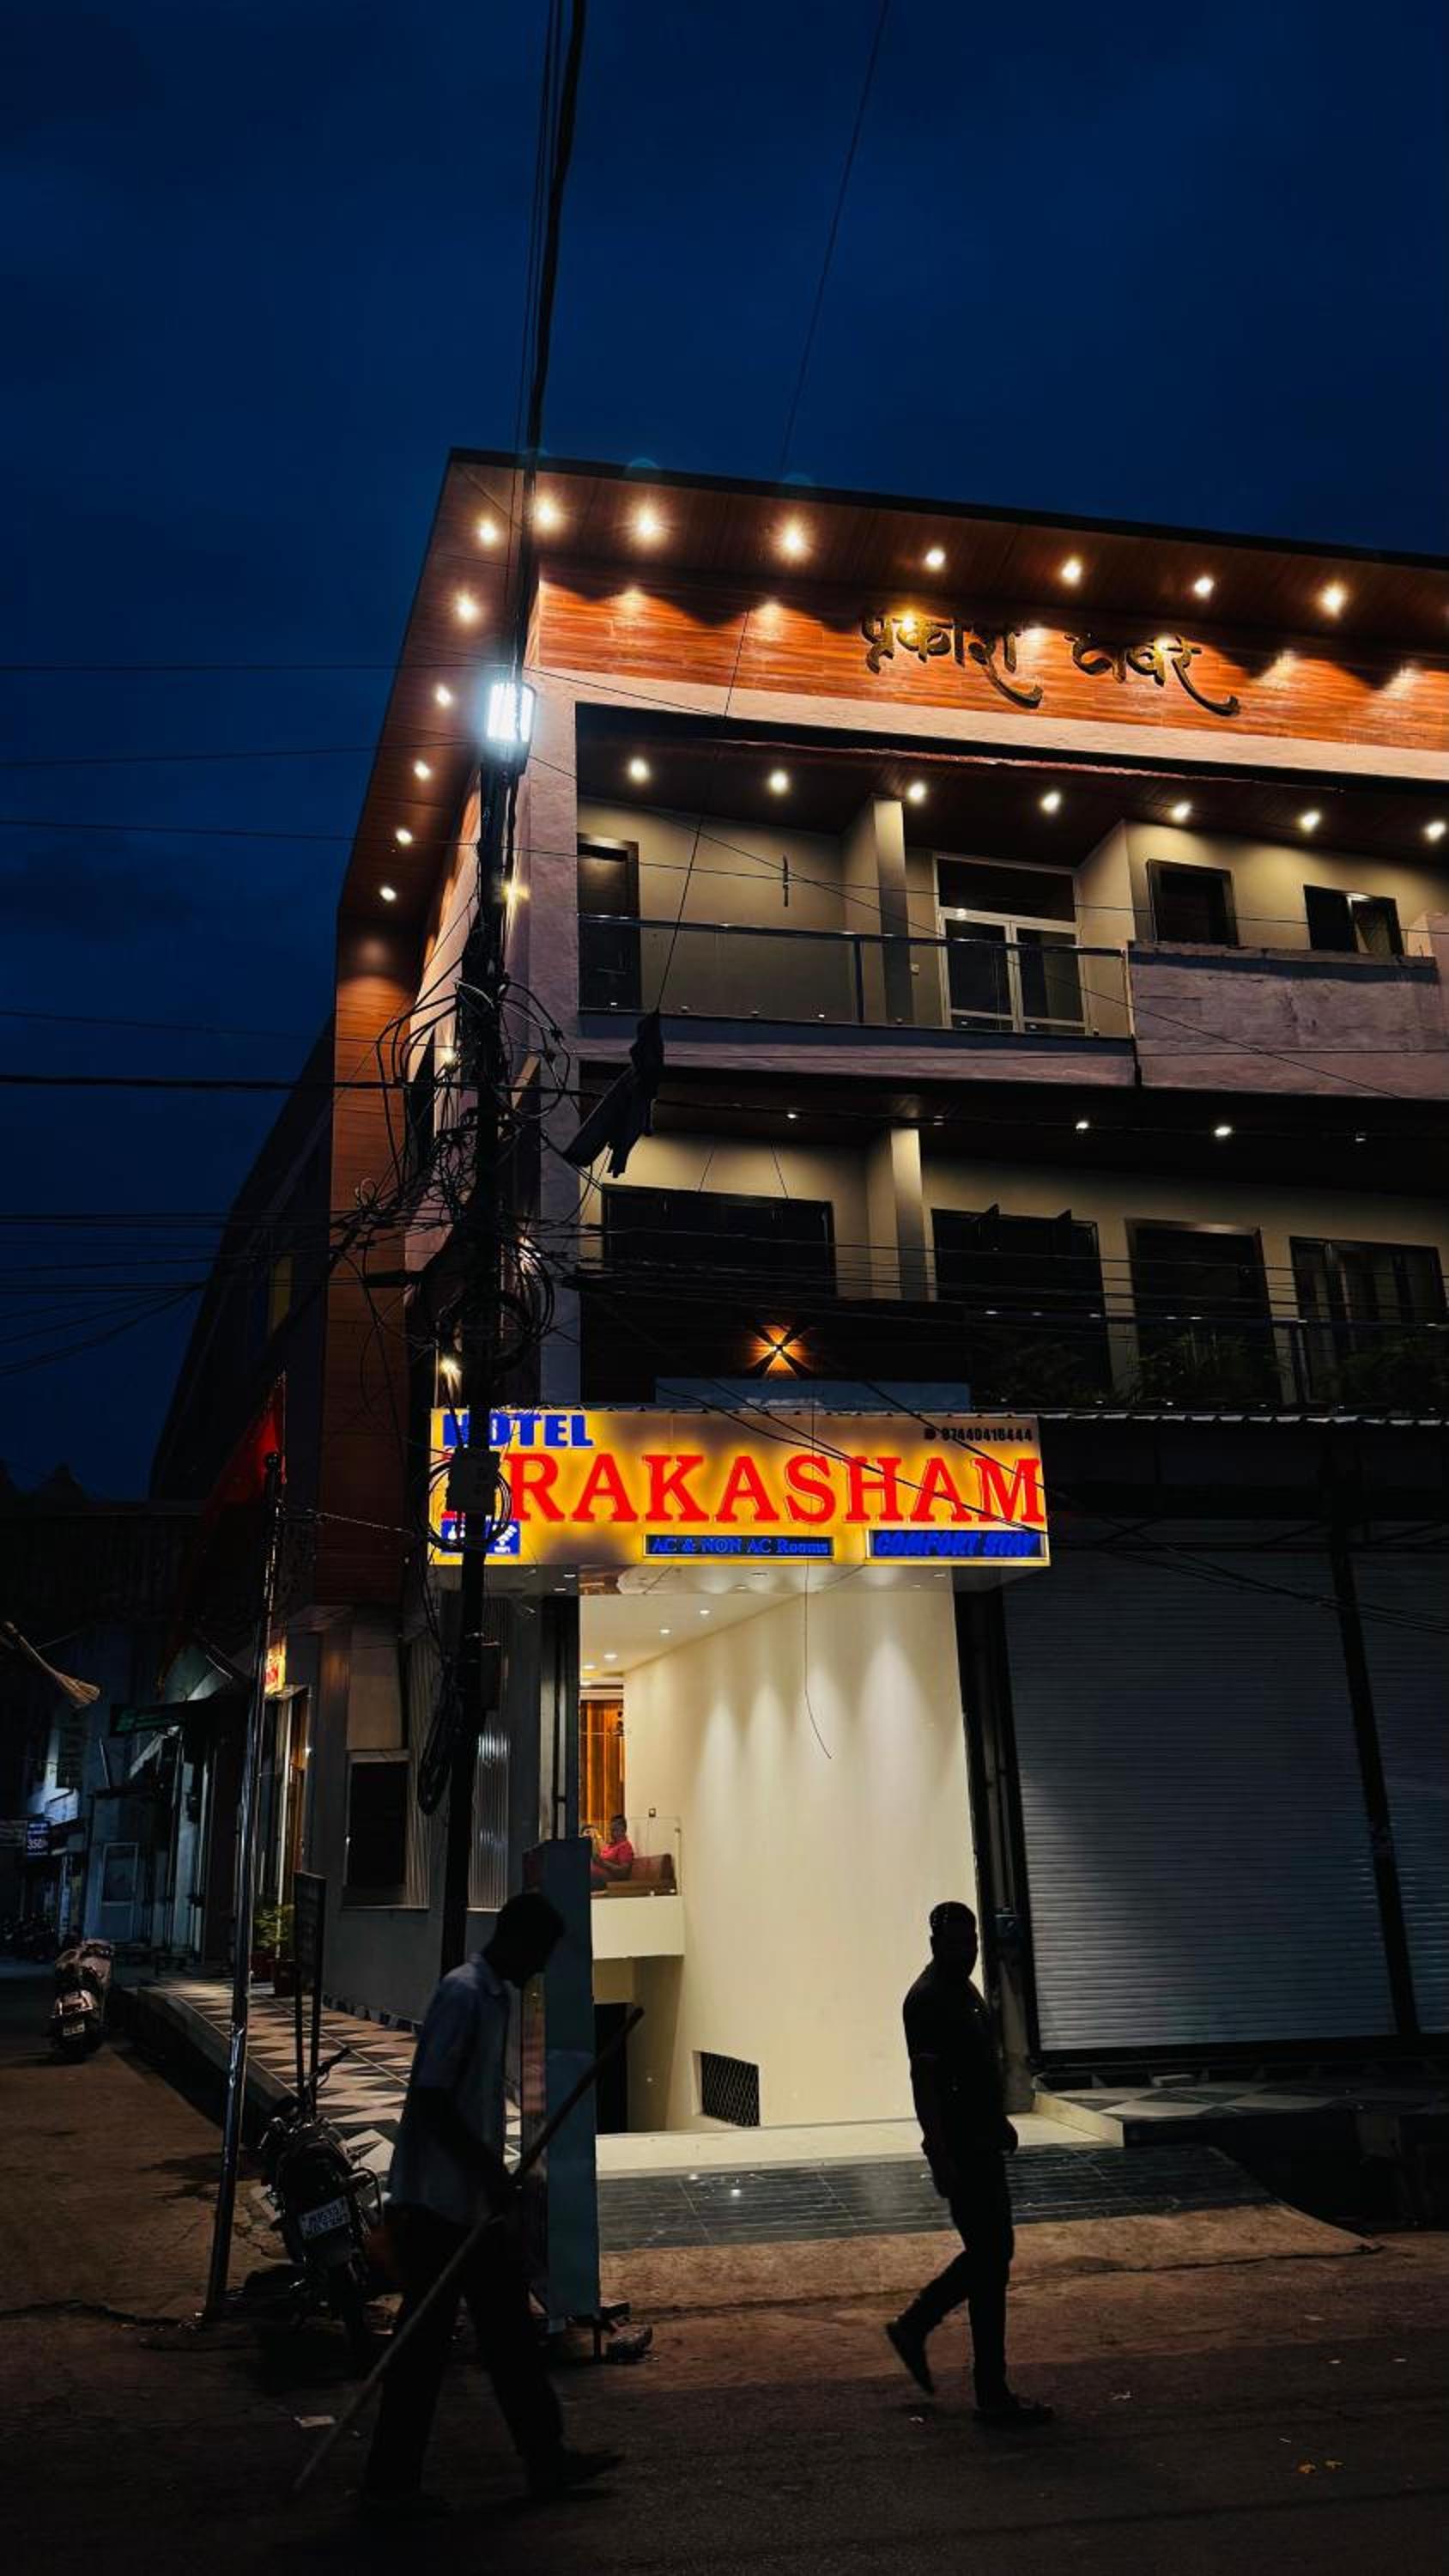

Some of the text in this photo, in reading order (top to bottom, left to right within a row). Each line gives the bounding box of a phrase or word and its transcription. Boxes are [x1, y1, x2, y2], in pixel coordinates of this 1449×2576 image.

[441, 1452, 1047, 1524] RAKASHAM
[651, 1537, 678, 1553] AC
[700, 1537, 743, 1553] NON
[746, 1537, 773, 1553] AC
[775, 1537, 829, 1554] Rooms
